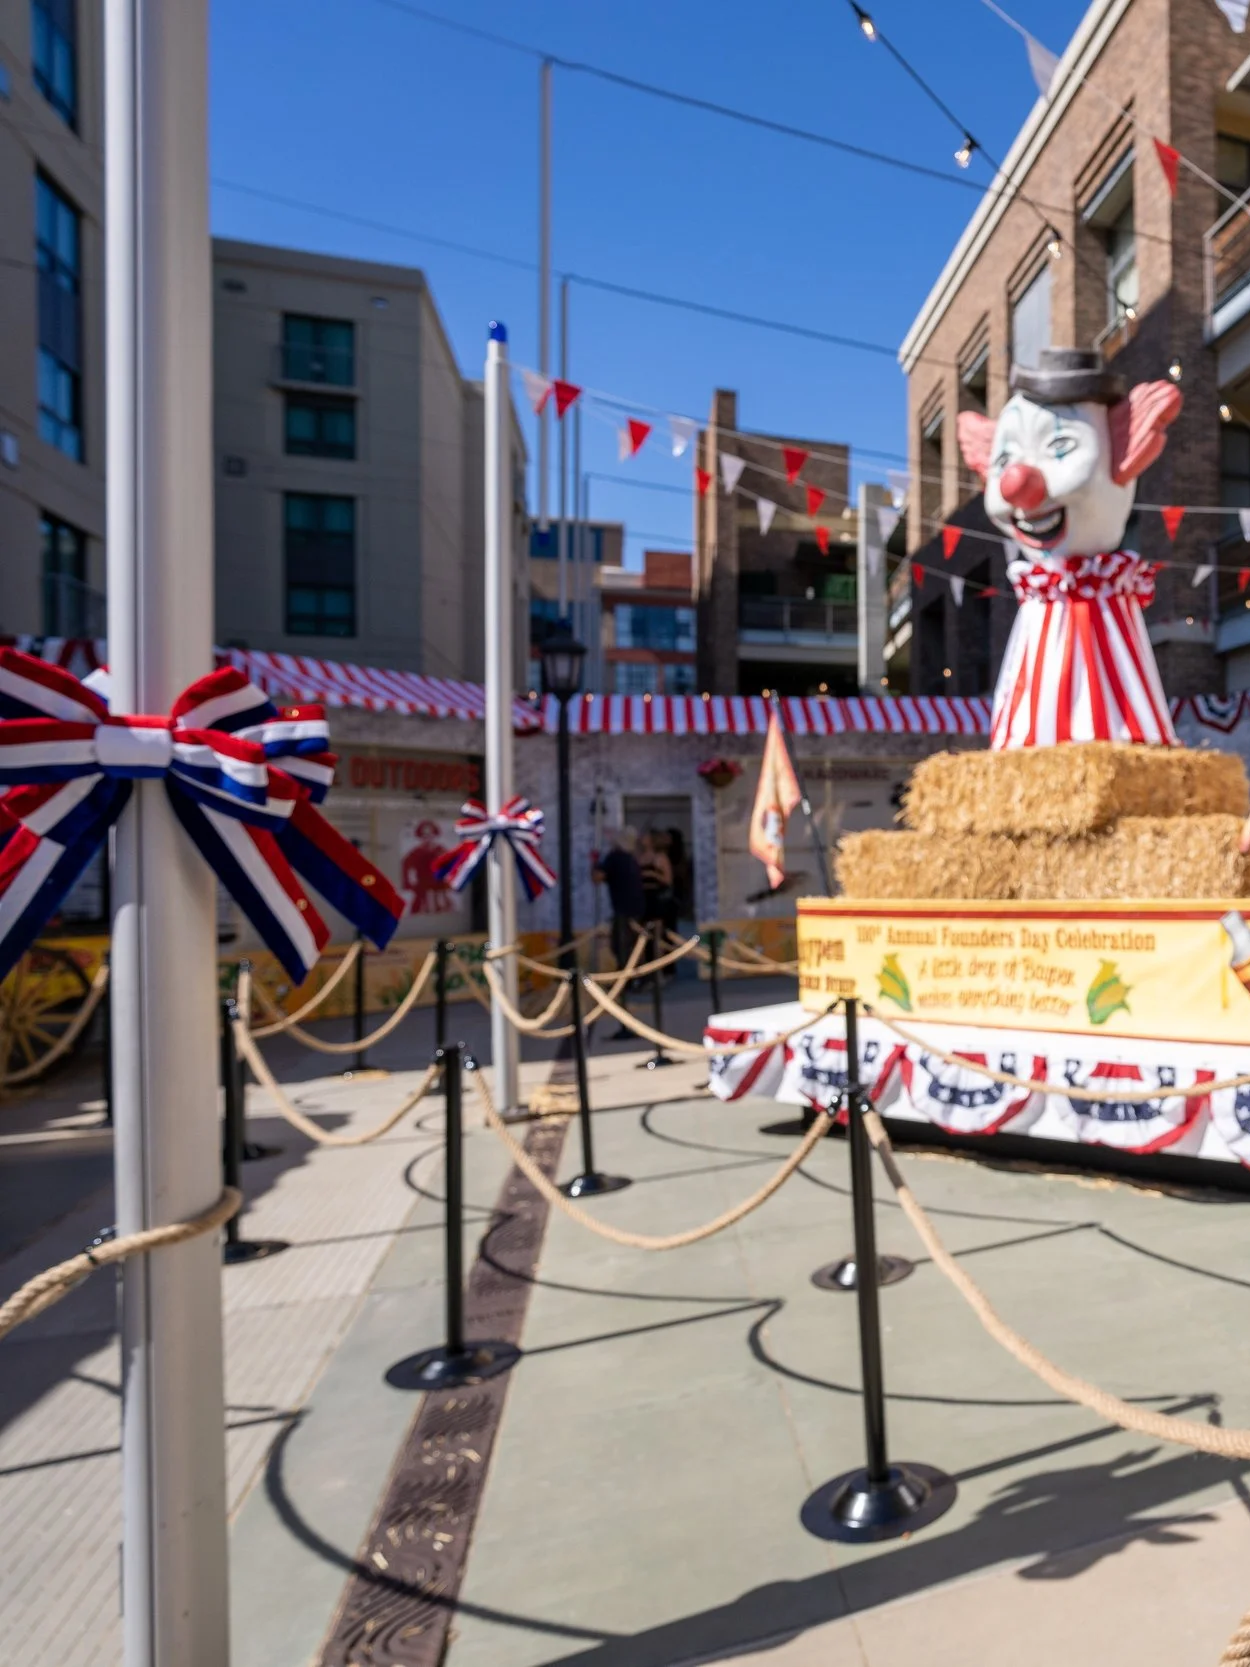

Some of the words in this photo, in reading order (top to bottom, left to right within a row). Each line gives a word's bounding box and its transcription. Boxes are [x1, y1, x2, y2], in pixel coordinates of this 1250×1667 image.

[887, 926, 937, 945] Annual
[942, 926, 1014, 947] Founders
[1021, 927, 1049, 953] Day
[1056, 927, 1156, 951] Celebration
